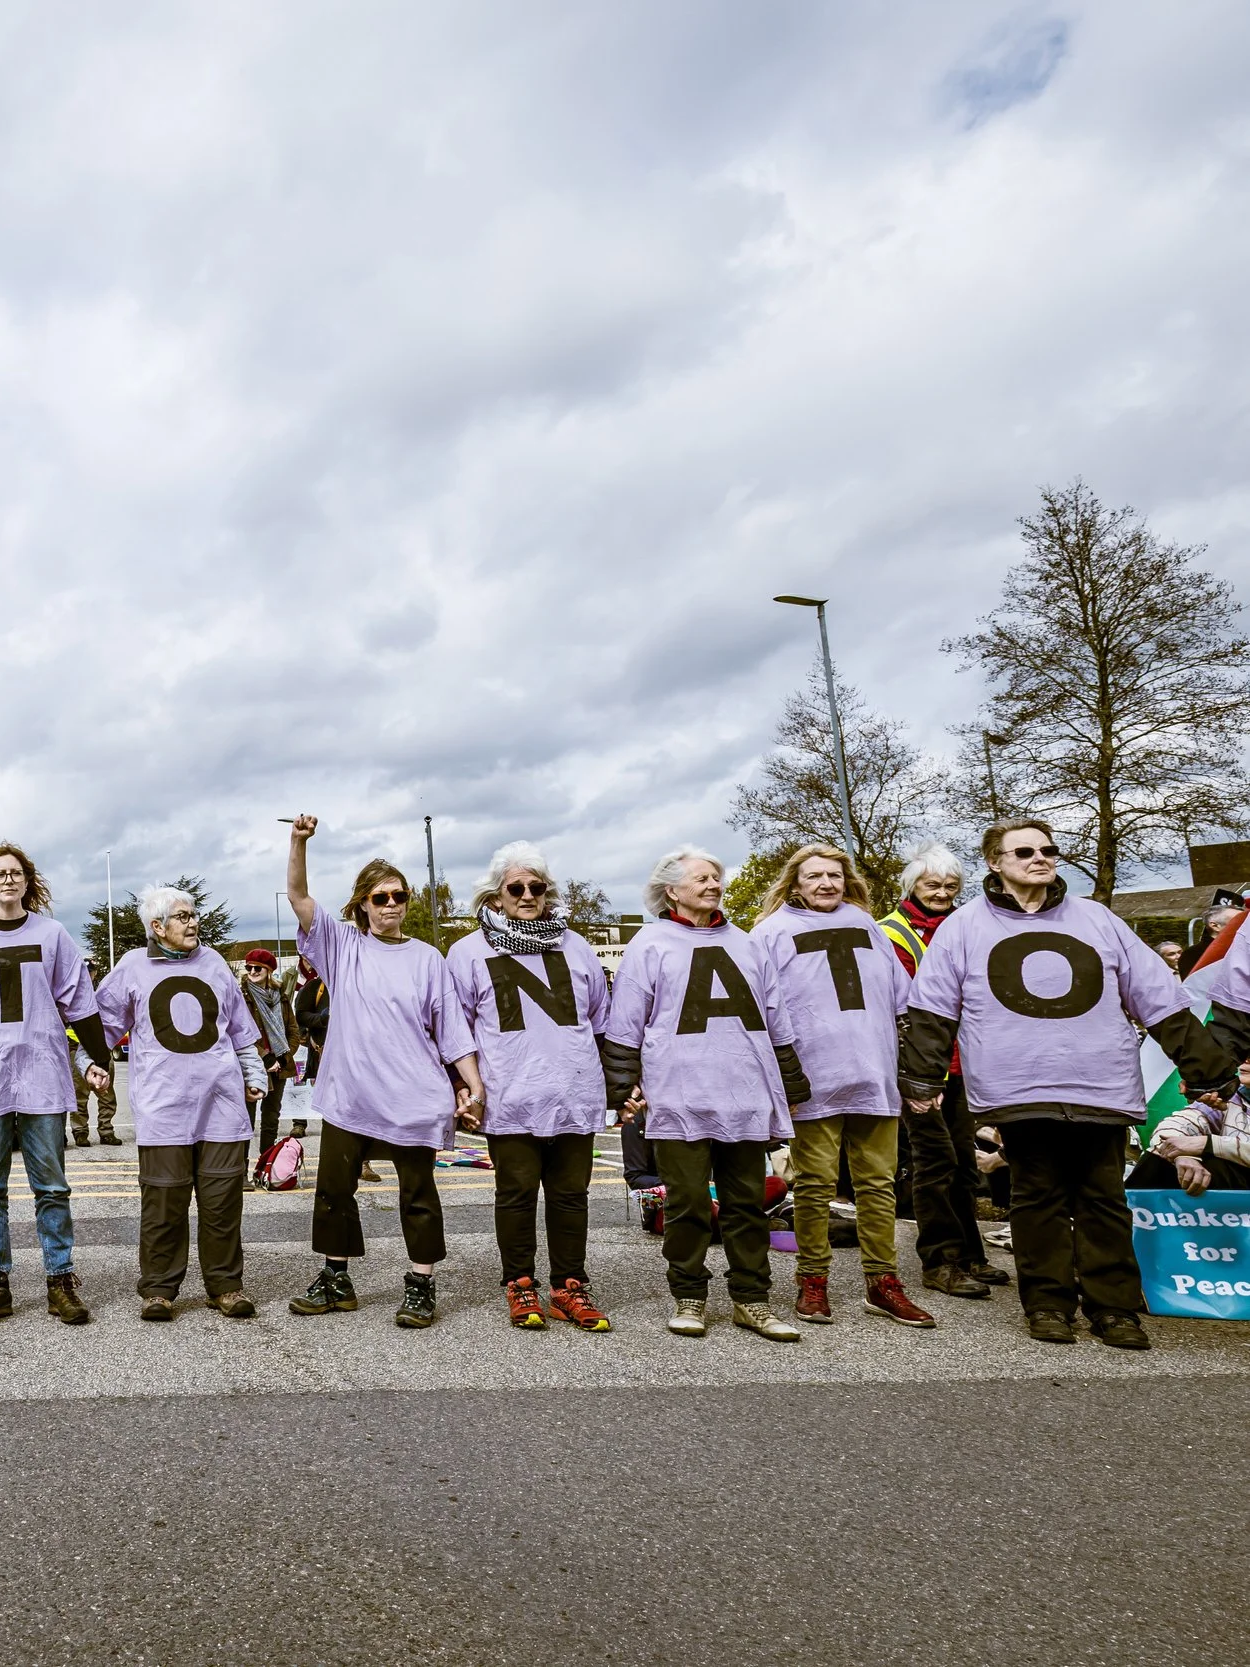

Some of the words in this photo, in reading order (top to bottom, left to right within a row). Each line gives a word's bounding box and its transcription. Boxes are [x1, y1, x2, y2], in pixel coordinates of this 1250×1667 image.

[485, 949, 579, 1033] N
[677, 946, 766, 1035] A
[793, 927, 873, 1011] T
[988, 931, 1104, 1019] O
[149, 976, 219, 1054] O
[1182, 1241, 1238, 1262] for
